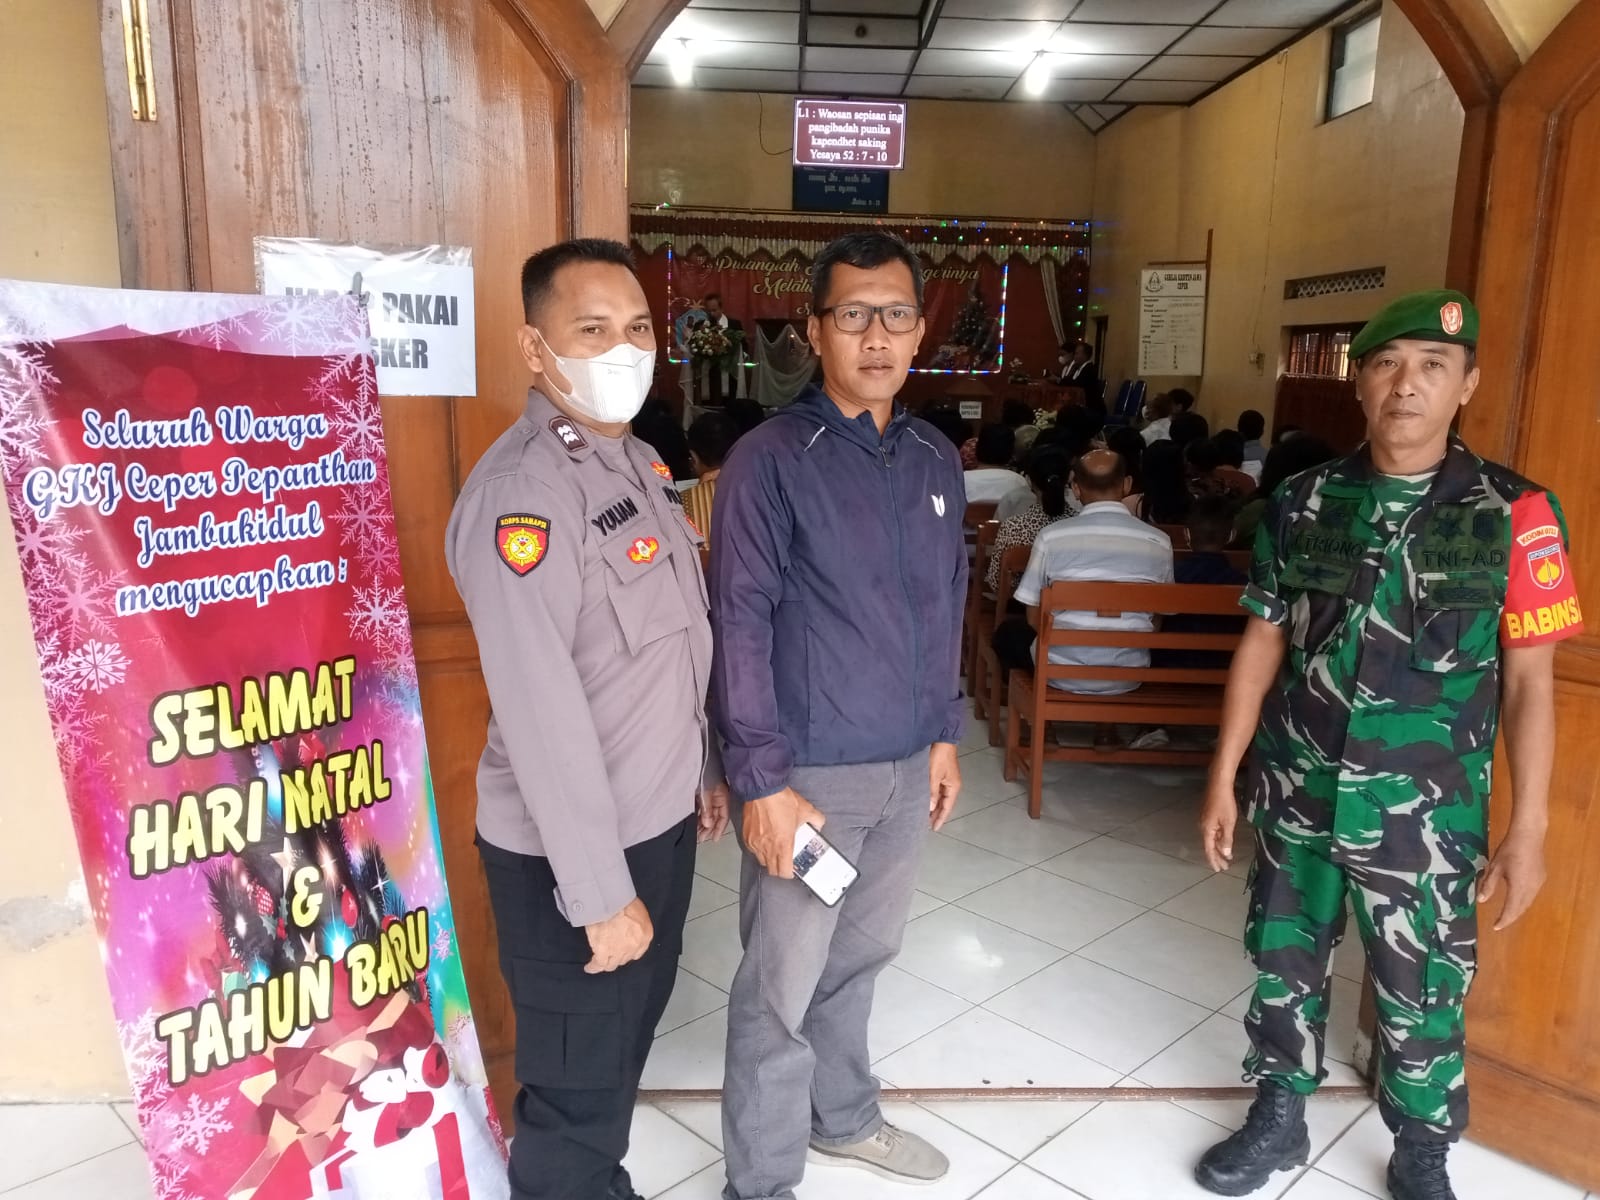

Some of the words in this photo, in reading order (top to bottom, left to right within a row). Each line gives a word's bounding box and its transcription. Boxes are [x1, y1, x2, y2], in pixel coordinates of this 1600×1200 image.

[808, 122, 858, 134] pangibadah
[860, 124, 891, 135] punika
[818, 109, 852, 119] Waosan
[854, 110, 886, 121] sepisan
[810, 149, 840, 161] Yesaya
[843, 151, 854, 160] 52
[862, 151, 868, 160] 7
[877, 151, 887, 161] 10
[858, 138, 887, 150] saking
[382, 292, 458, 326] PAKAI
[83, 408, 210, 447] Seluruh
[217, 407, 326, 448] Warga
[24, 465, 121, 516] GKJ
[128, 471, 214, 512] Ceper
[223, 455, 376, 502] Pepanthan
[134, 504, 324, 568] Jambukidul
[591, 496, 639, 536] YULIAN
[1422, 549, 1506, 568] TNI-AD
[117, 561, 332, 616] mengucapkan
[1505, 594, 1583, 639] BABINS
[150, 656, 356, 765] SELAMAT
[127, 780, 270, 879] HARI
[279, 742, 392, 835] NATAL
[290, 864, 324, 928] &
[155, 957, 334, 1087] TAHUN
[346, 908, 430, 1010] BARU
